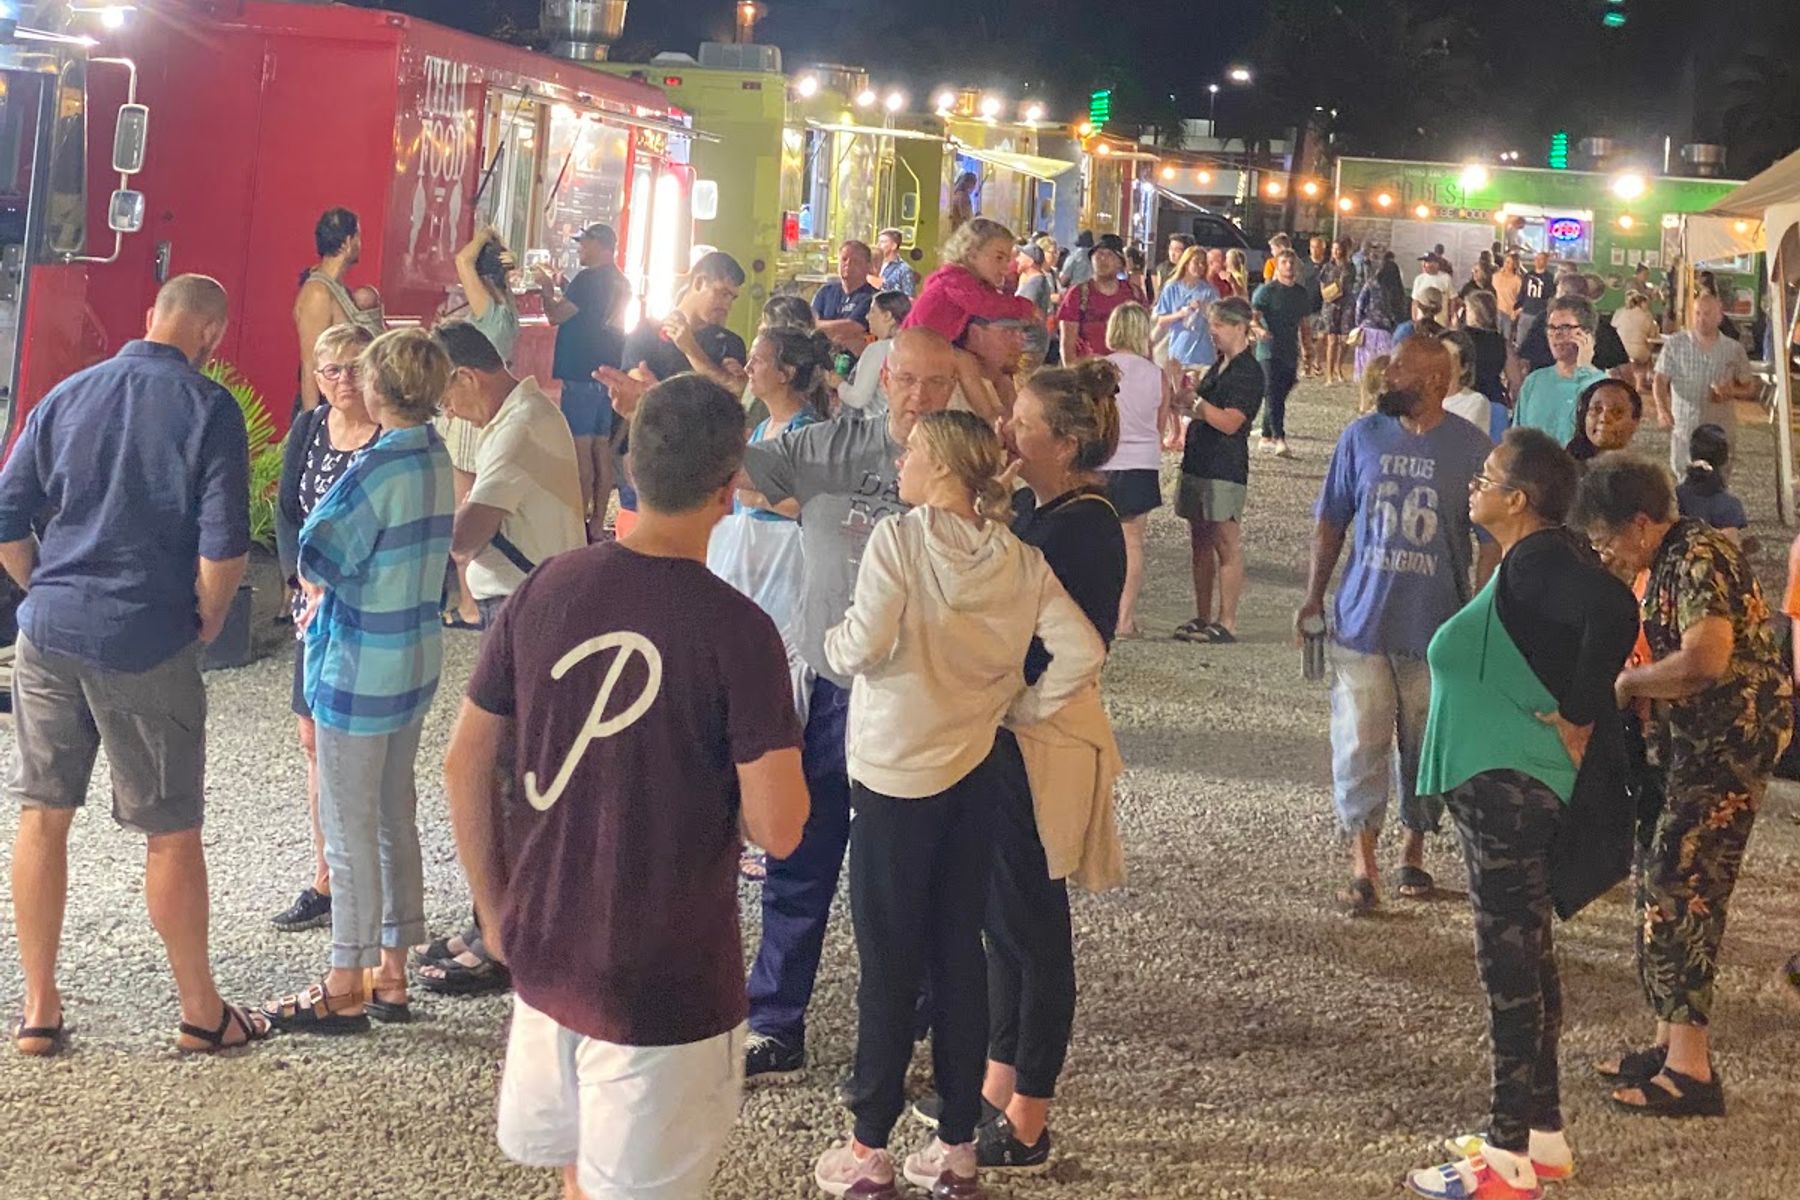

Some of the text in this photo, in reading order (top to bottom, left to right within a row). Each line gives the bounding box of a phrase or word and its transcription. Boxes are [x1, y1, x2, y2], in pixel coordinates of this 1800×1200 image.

[423, 55, 468, 117] THAI
[417, 119, 467, 181] FOOD
[524, 631, 663, 811] P
